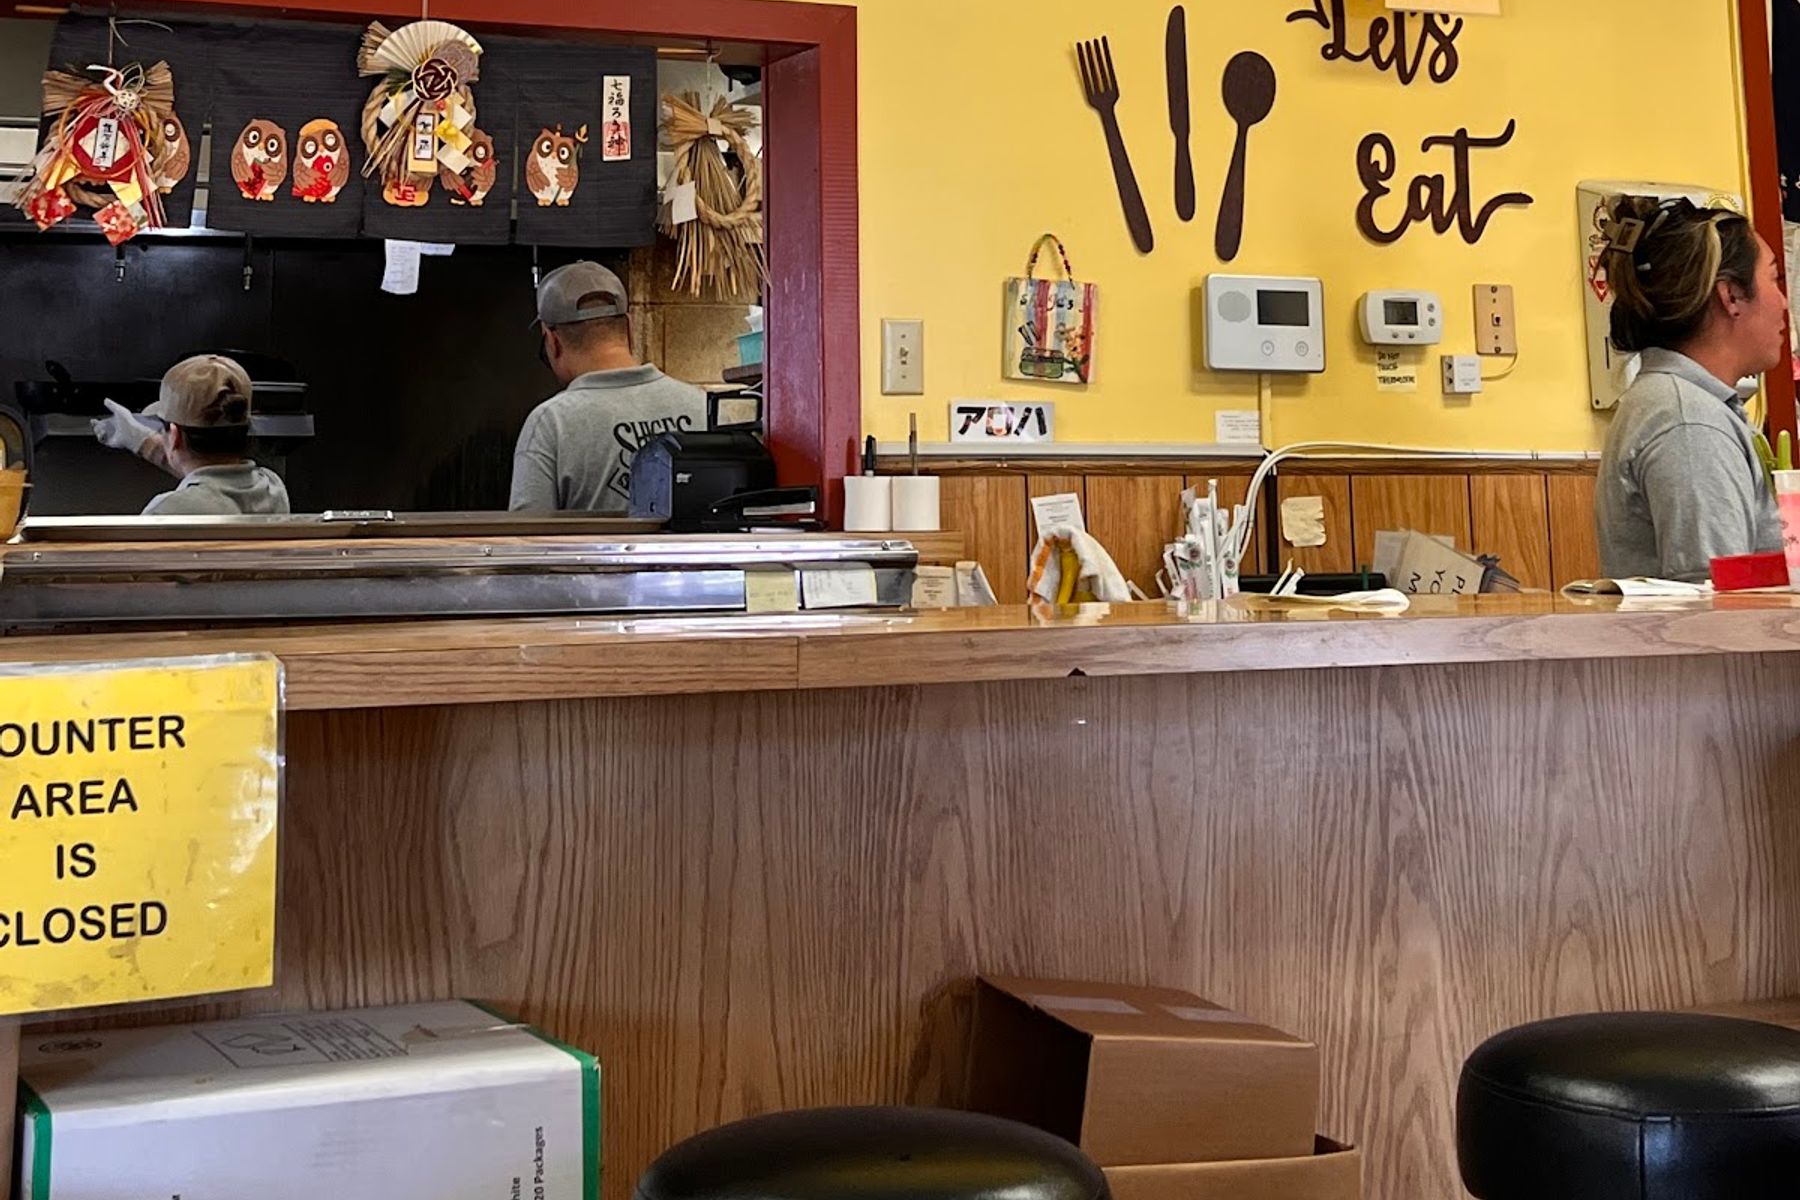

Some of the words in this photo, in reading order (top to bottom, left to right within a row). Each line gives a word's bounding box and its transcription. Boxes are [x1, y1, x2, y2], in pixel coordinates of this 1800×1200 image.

[1355, 119, 1534, 245] Eat
[956, 406, 1047, 436] アロハ
[11, 778, 138, 820] AREA
[57, 842, 97, 879] IS
[533, 1126, 545, 1184] Packages
